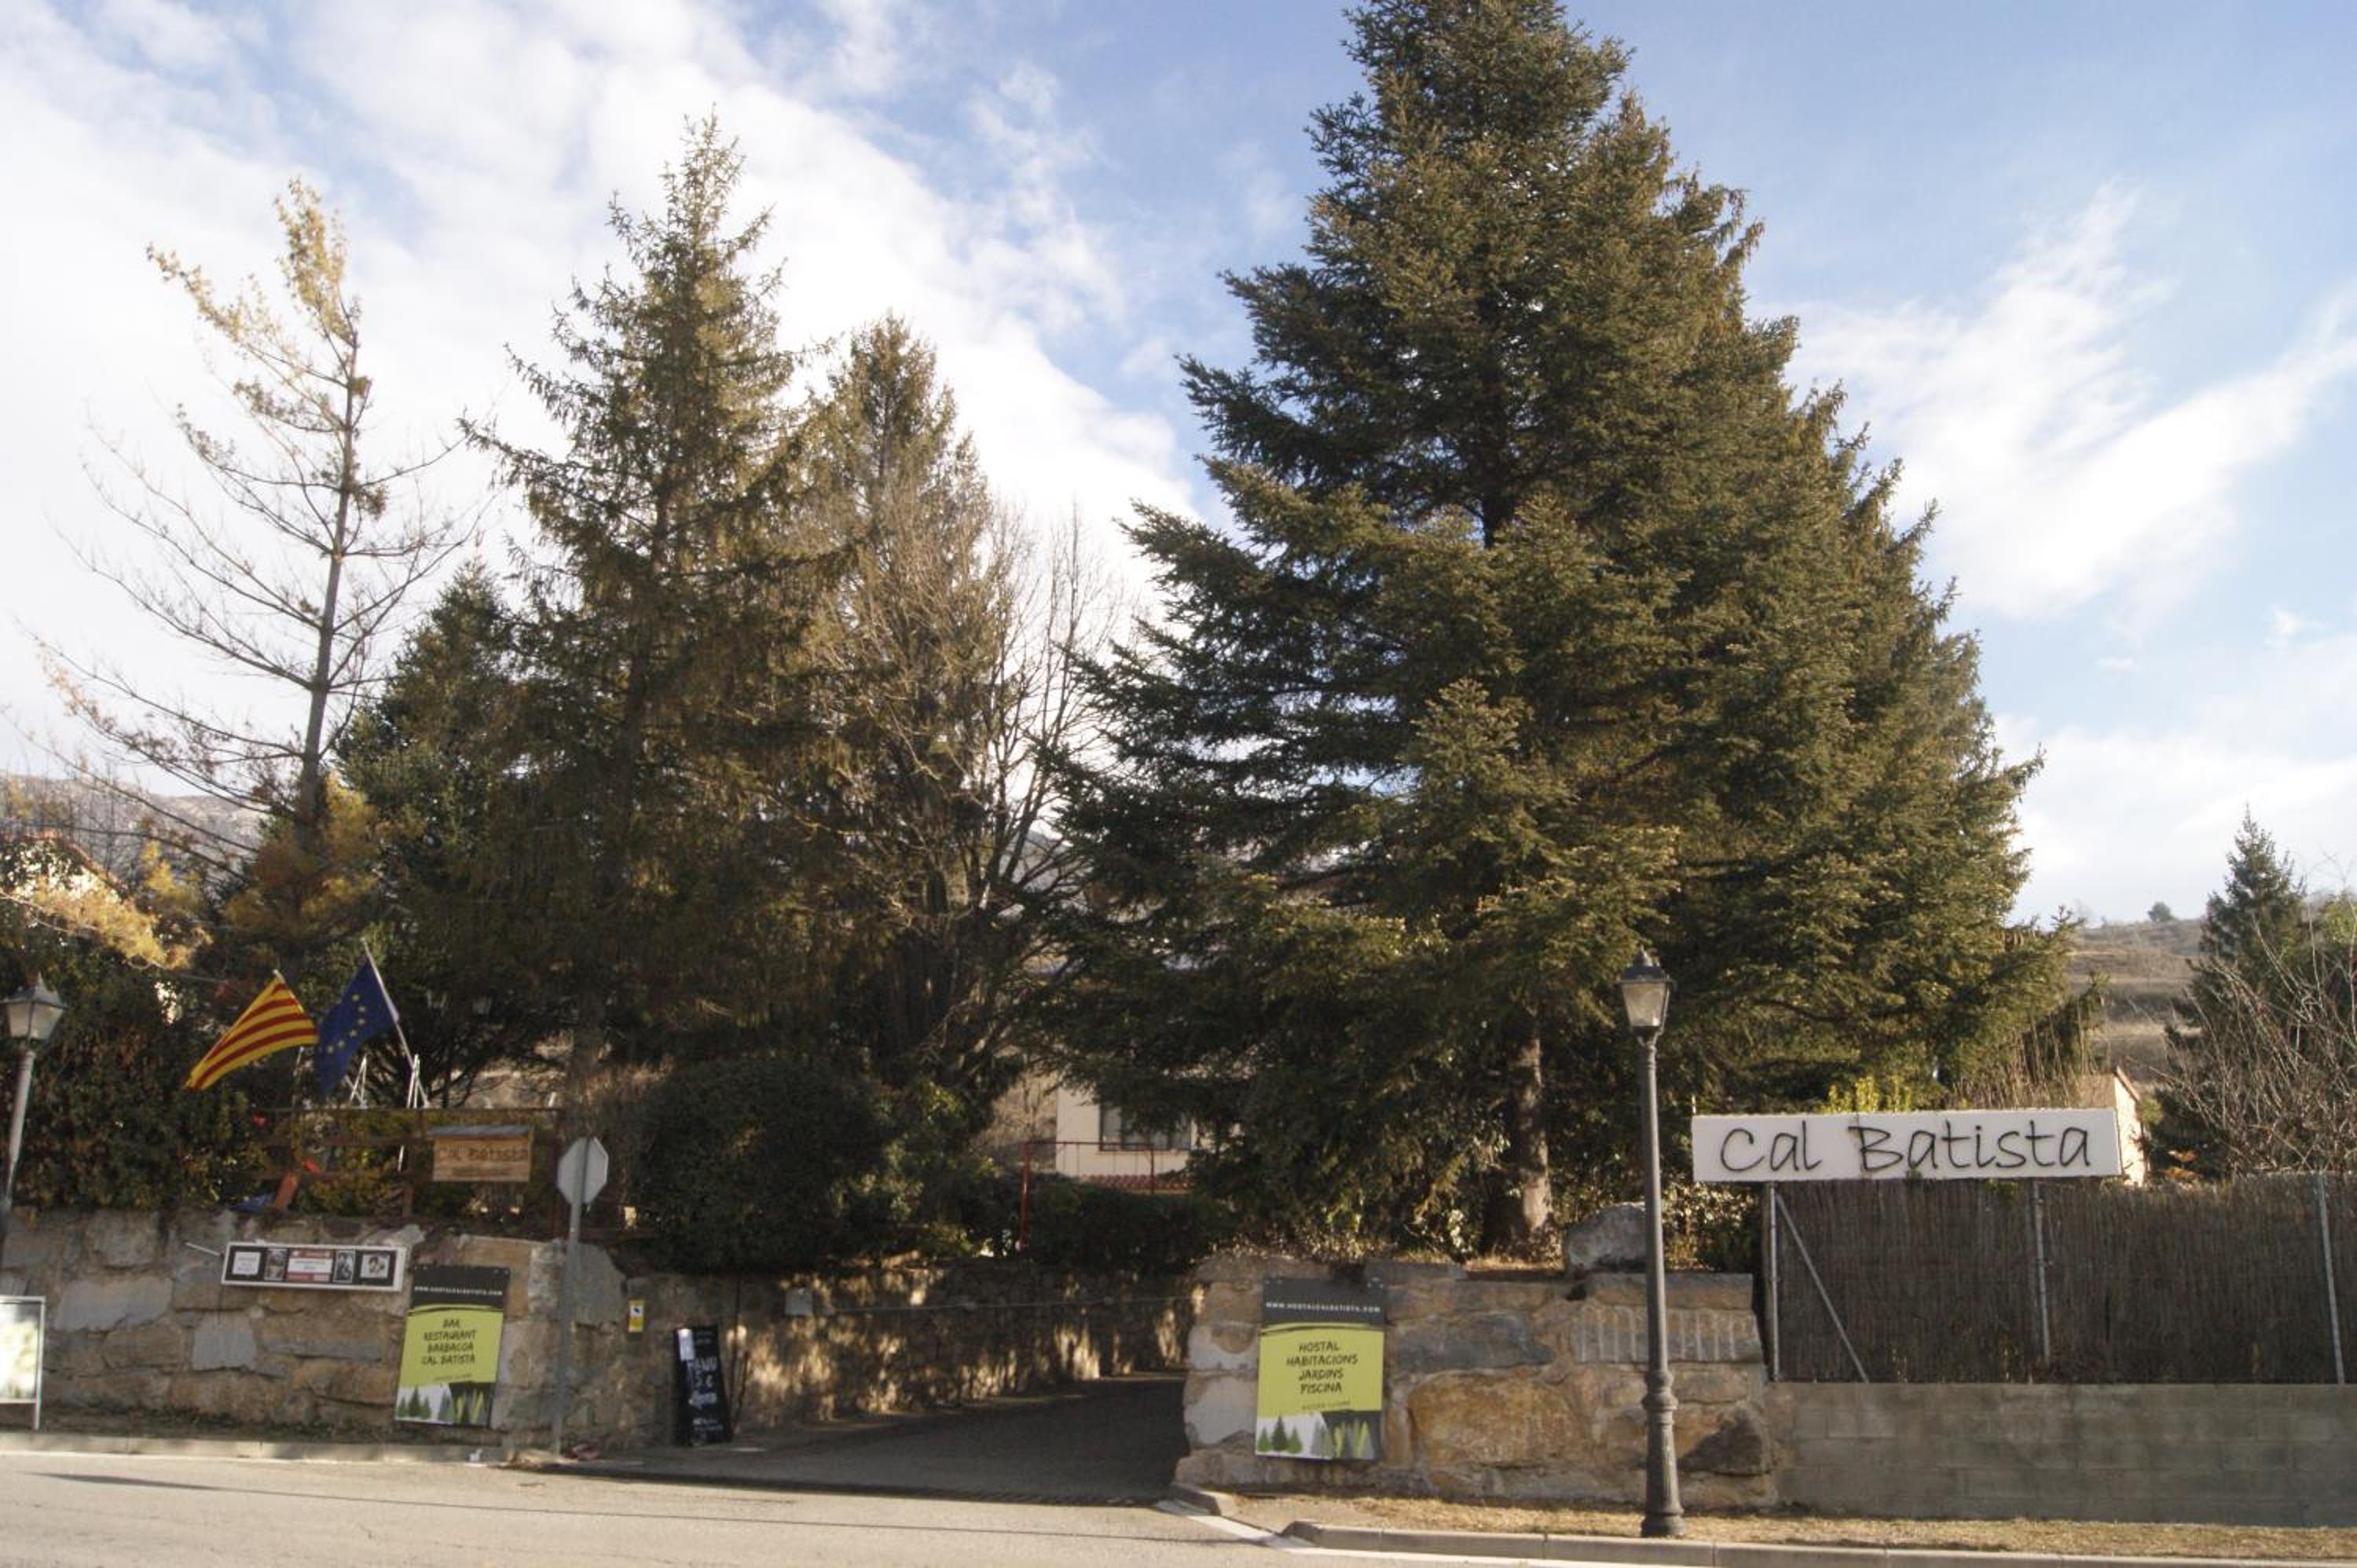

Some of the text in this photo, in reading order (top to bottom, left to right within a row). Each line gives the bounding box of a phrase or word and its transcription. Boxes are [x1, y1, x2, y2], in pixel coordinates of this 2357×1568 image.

[1720, 1119, 2091, 1172] Cal Batista
[423, 1329, 477, 1341] RESTAURANT
[1299, 1341, 1340, 1352] HOSTAL
[440, 1354, 475, 1365] BATISTA
[1285, 1354, 1358, 1366] HABITACIONS
[1299, 1367, 1344, 1381] JARDINS
[1300, 1382, 1343, 1394] PISCINA
